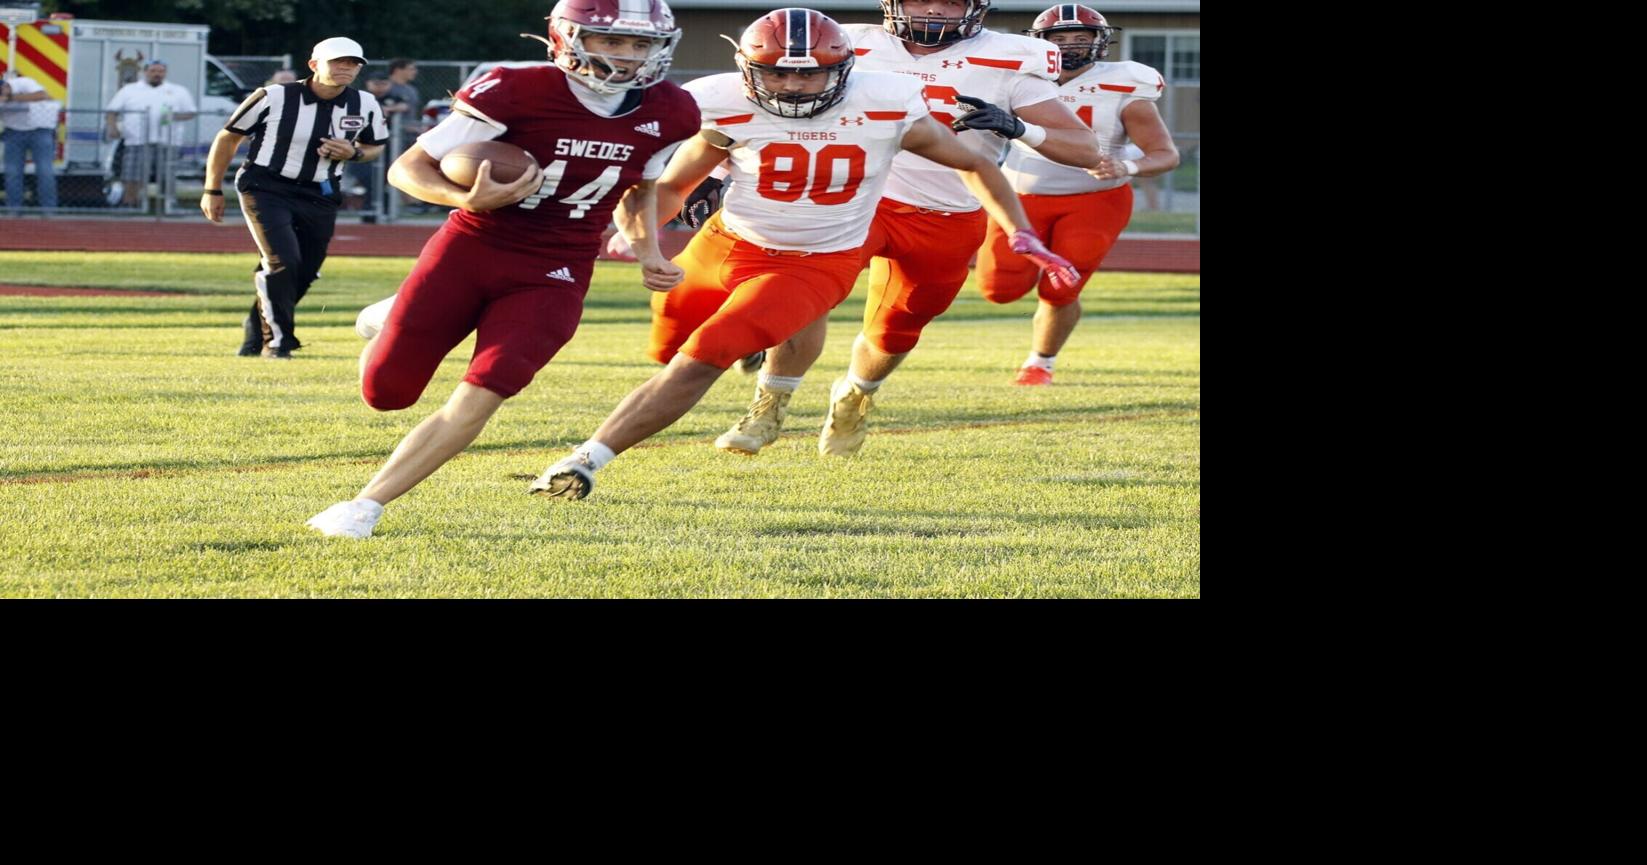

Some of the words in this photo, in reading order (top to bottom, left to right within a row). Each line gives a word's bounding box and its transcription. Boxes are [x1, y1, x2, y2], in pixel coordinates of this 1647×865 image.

[554, 138, 635, 161] SWEDES
[786, 131, 837, 141] TIGERS
[517, 159, 623, 219] 14
[756, 142, 867, 206] 80
